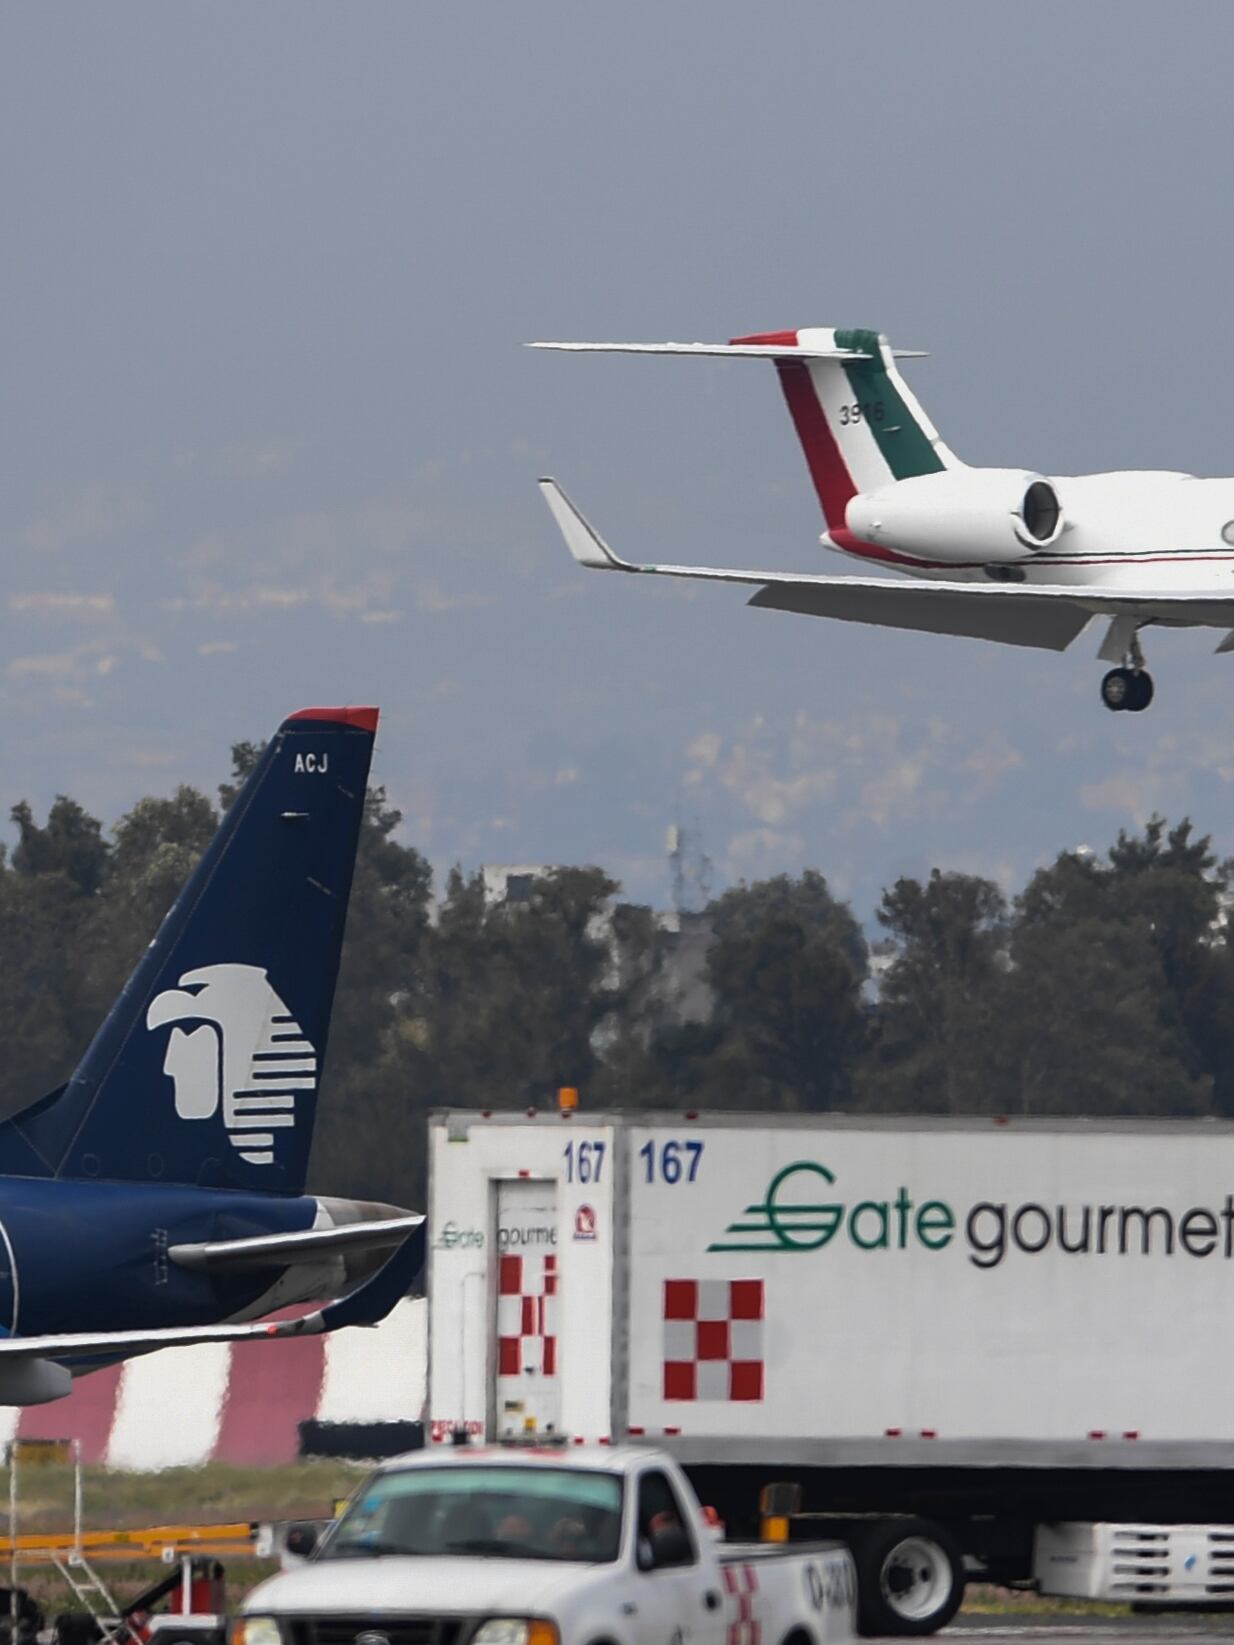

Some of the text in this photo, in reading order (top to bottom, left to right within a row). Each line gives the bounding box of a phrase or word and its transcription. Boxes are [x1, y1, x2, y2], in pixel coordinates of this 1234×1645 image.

[294, 753, 328, 773] ACJ
[563, 1139, 606, 1184] 167
[639, 1139, 704, 1184] 167
[707, 1160, 956, 1251] Gate
